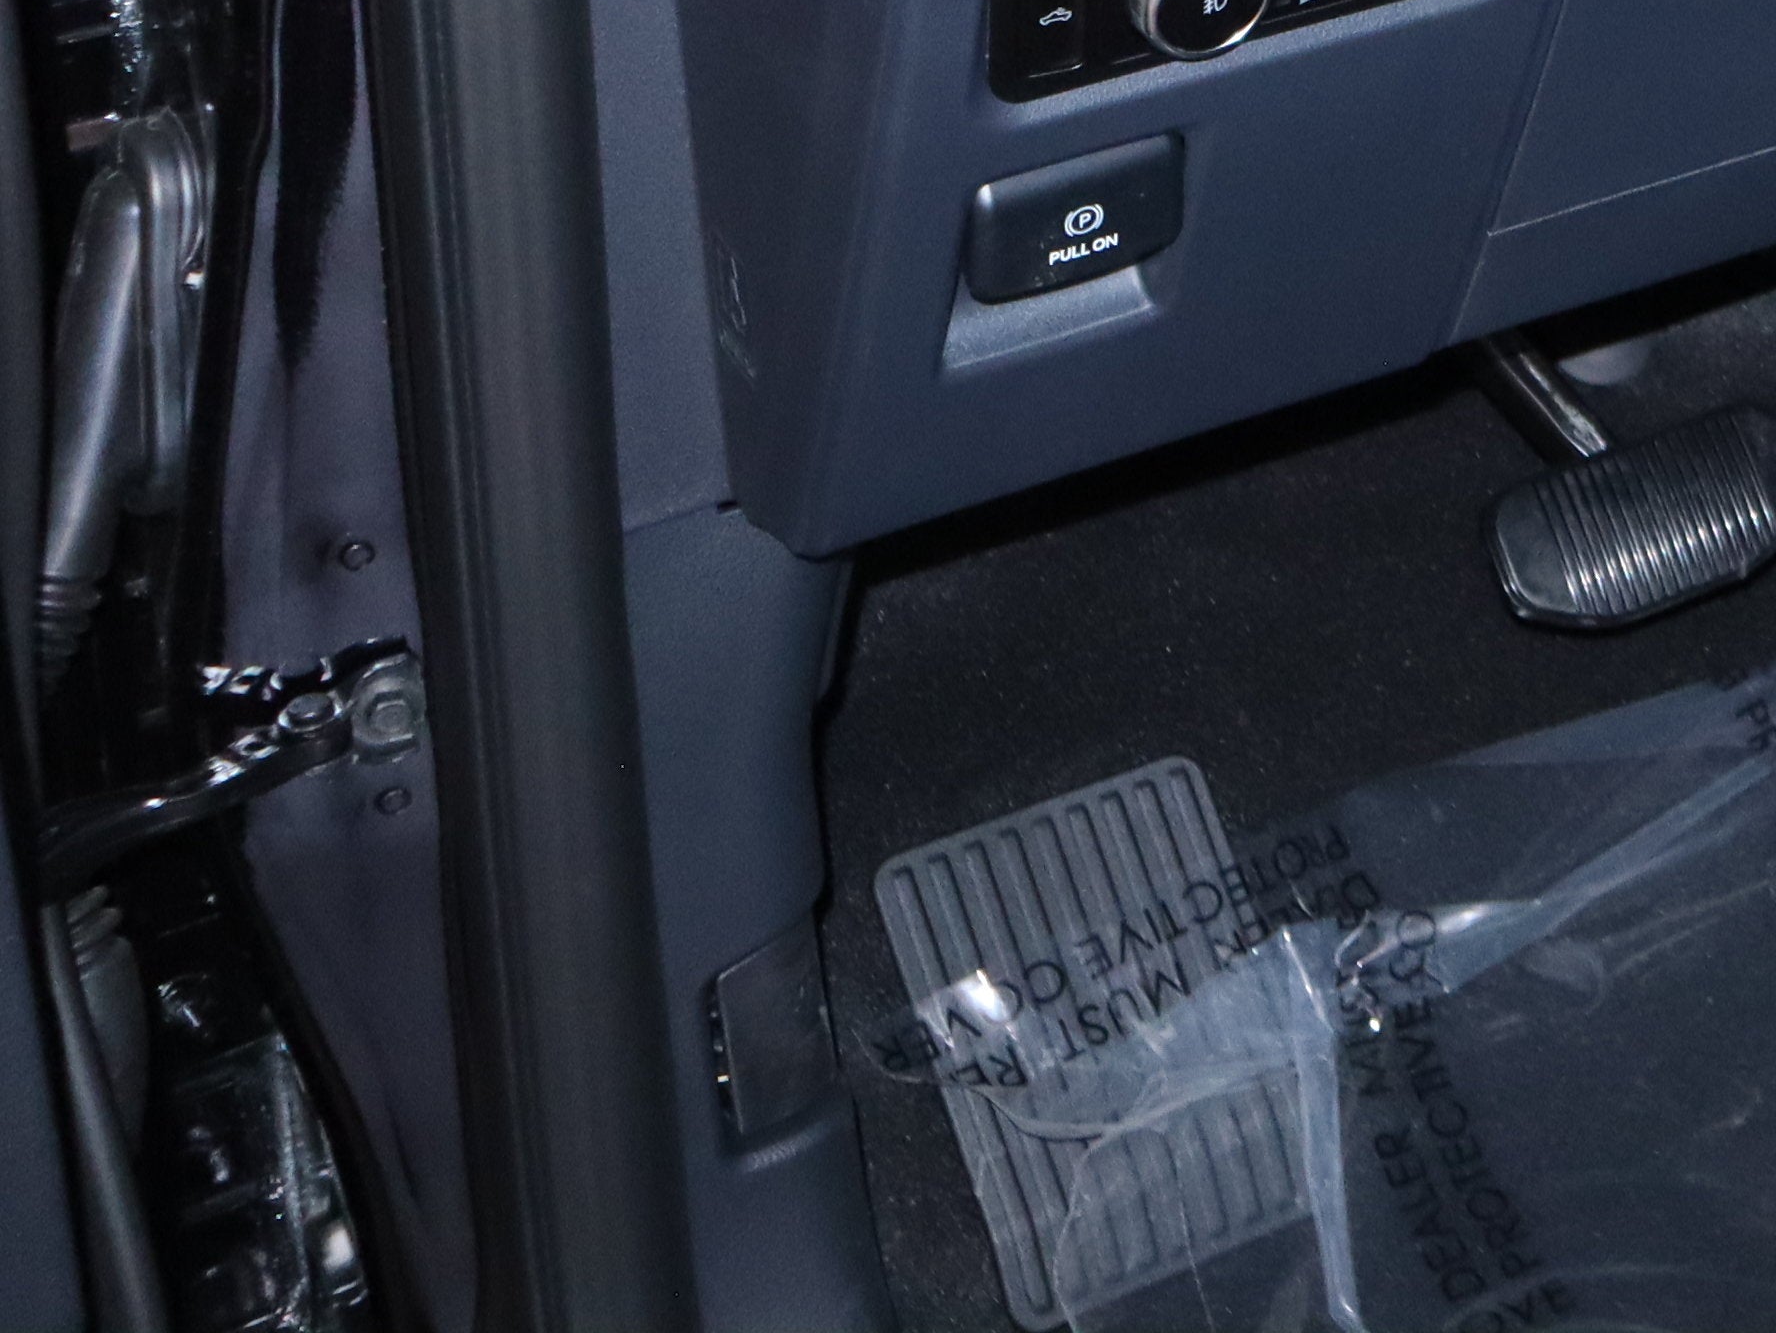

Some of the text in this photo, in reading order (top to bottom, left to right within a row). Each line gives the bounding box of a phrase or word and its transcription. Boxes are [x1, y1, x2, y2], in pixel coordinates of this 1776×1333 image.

[1049, 231, 1120, 266] PULL ON
[1073, 823, 1352, 984] PROTECTIVE
[1060, 965, 1193, 1065] MUST
[1373, 1132, 1485, 1303] DEALER
[1390, 997, 1534, 1279] PROTECTIVE
